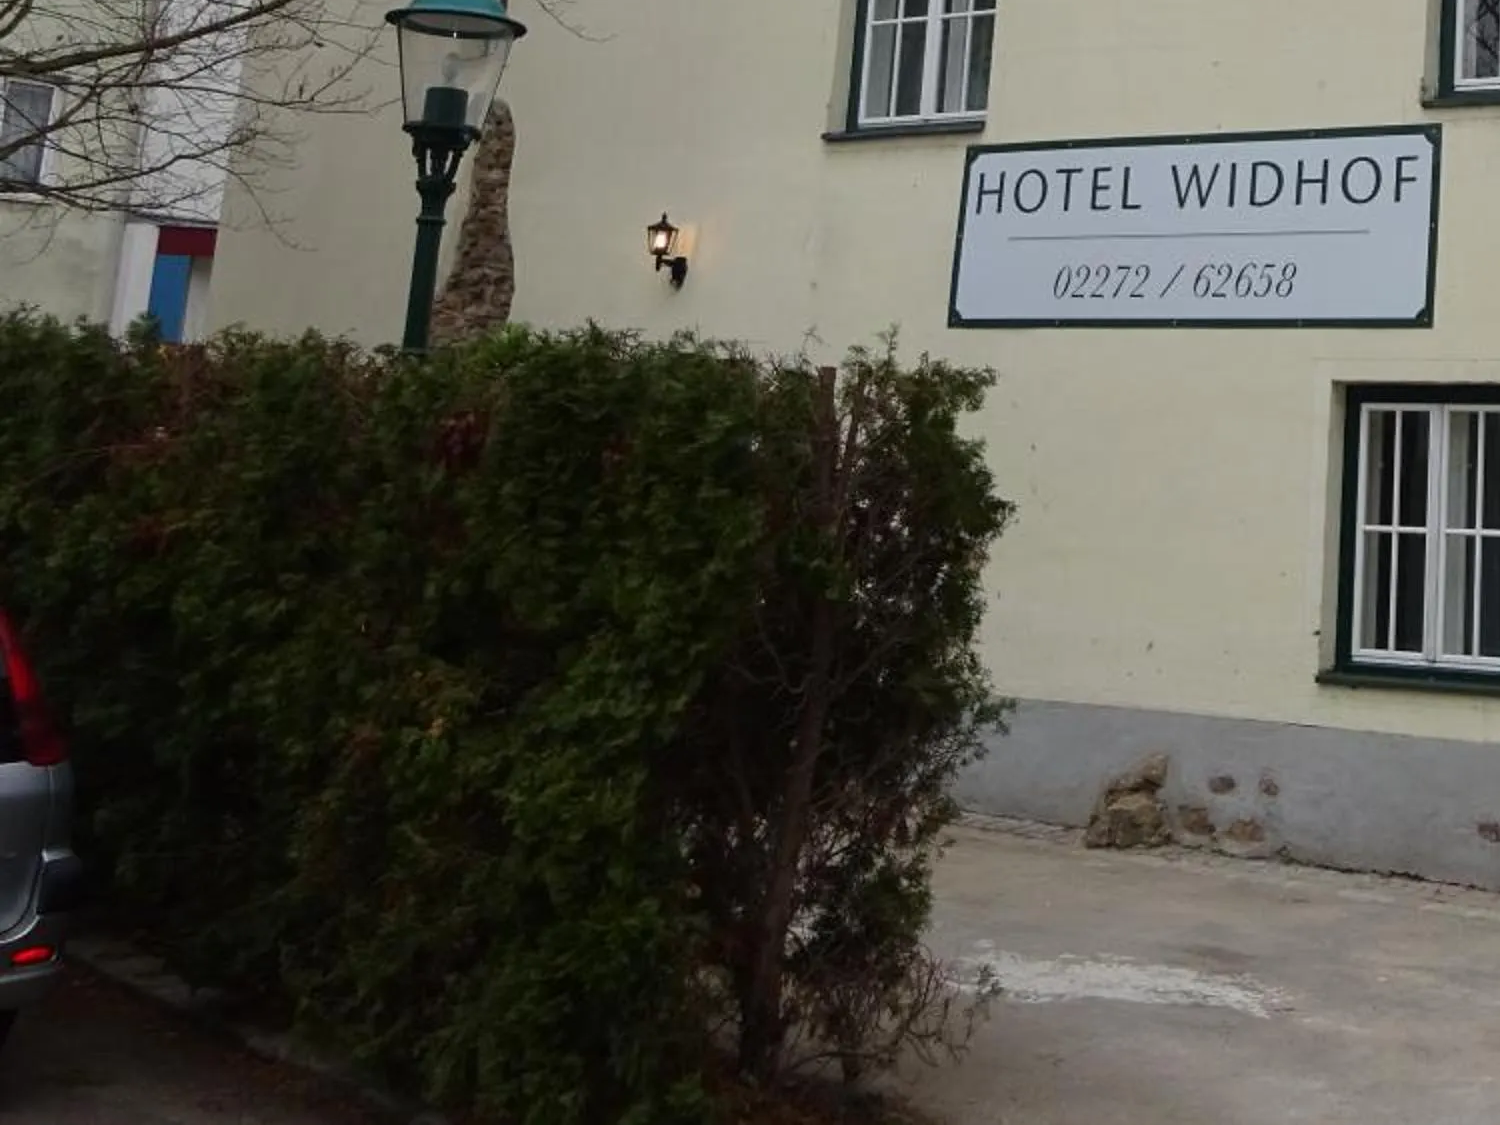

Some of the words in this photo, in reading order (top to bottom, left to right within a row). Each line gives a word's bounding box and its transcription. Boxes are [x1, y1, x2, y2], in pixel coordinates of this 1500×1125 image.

[975, 165, 1143, 215] HOTEL
[1171, 155, 1420, 210] WIDHOF
[1053, 264, 1151, 299] 02272
[1192, 262, 1298, 299] 62658
